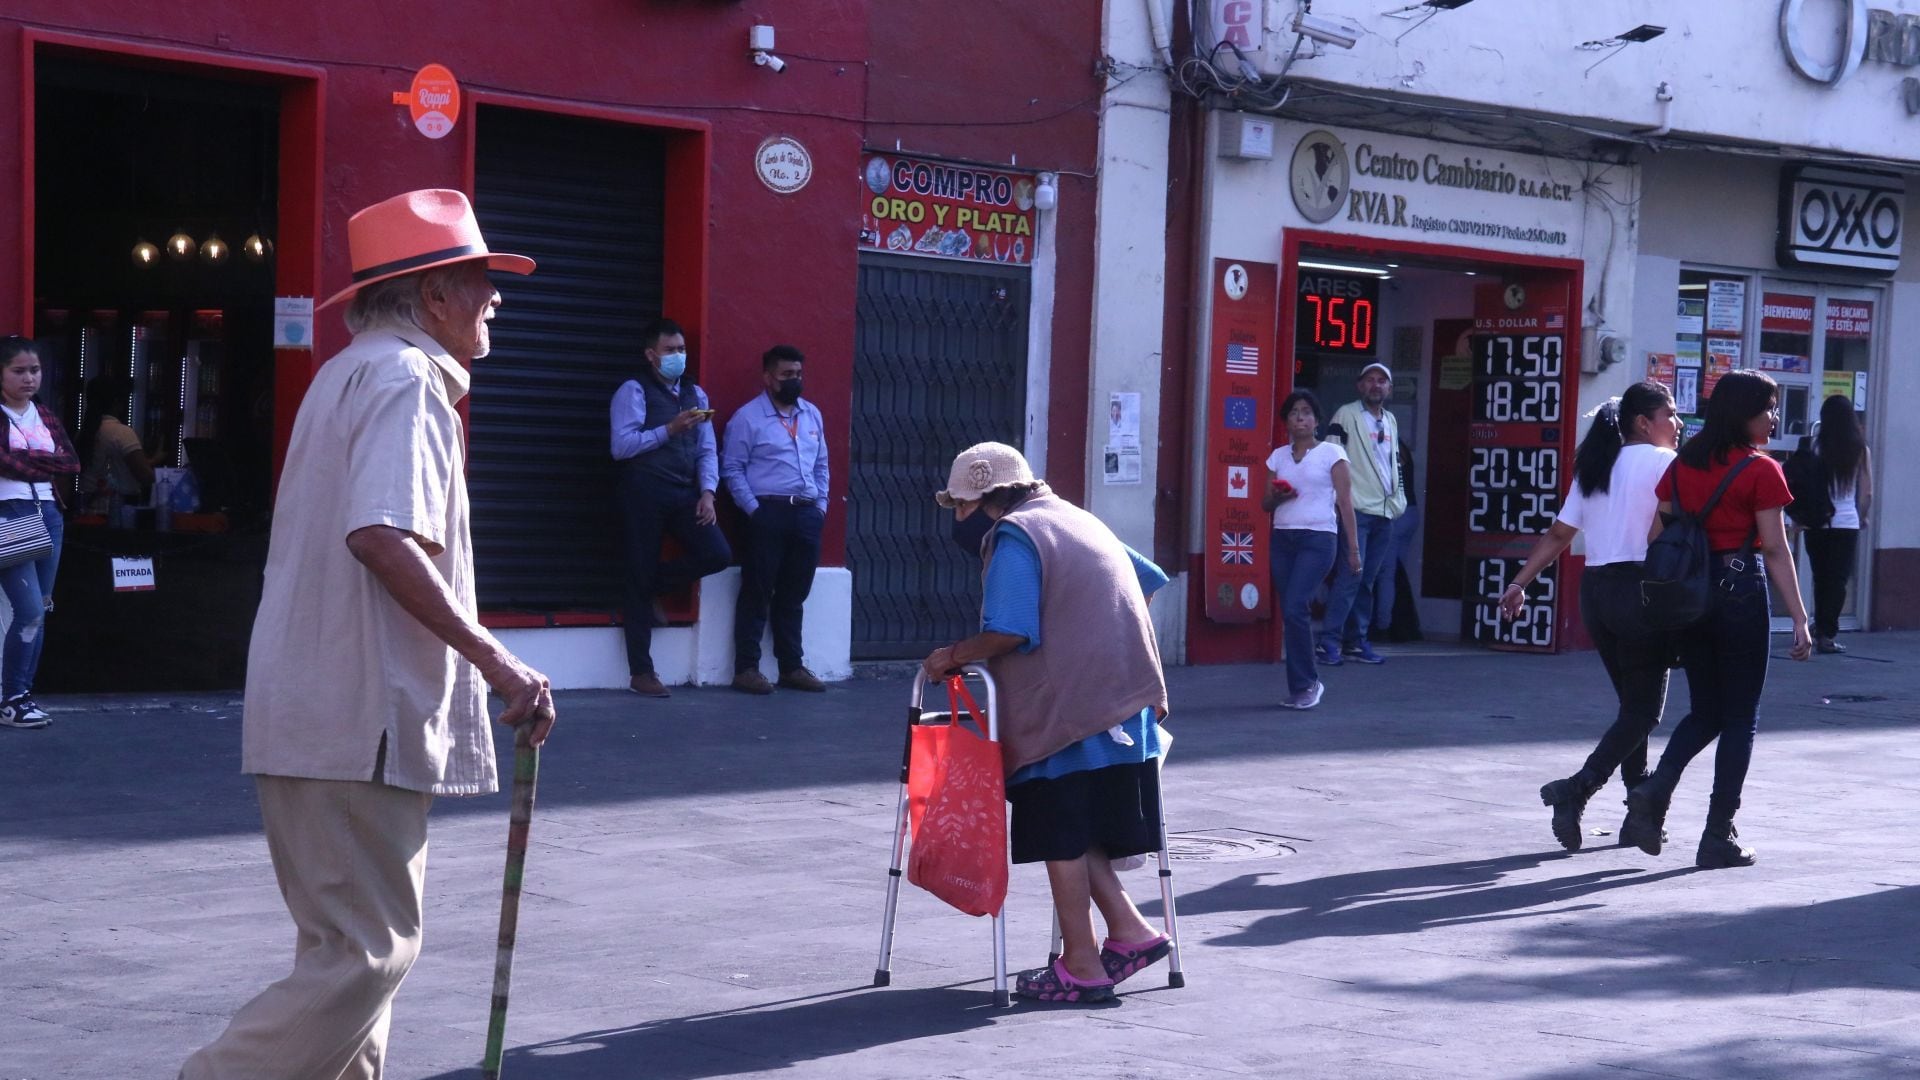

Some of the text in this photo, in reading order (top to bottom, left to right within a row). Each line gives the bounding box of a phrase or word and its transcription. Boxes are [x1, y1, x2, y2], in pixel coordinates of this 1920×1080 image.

[419, 88, 451, 109] Rappi
[770, 169, 801, 180] No. 2
[892, 159, 1012, 206] COMPRO
[1355, 143, 1418, 182] Centro
[1423, 153, 1516, 194] Cambiario
[1552, 184, 1571, 201] C.V.
[871, 197, 1031, 236] ORO Y PLATA
[1347, 189, 1408, 227] RVAR
[1411, 215, 1447, 233] Registro
[1800, 189, 1900, 249] OXXO
[1300, 276, 1362, 297] ARES
[1306, 295, 1371, 349] 7.50
[1475, 319, 1538, 328] U.S. DOLLAR
[1841, 307, 1868, 319] ENCANTA
[1486, 336, 1561, 377] 17.50
[1486, 381, 1561, 421] 18.20
[1470, 448, 1557, 489] 20.40
[1469, 491, 1557, 533] 21.25
[115, 568, 153, 578] ENTRADA
[1479, 559, 1554, 601] 135
[1475, 604, 1552, 646] 14.20
